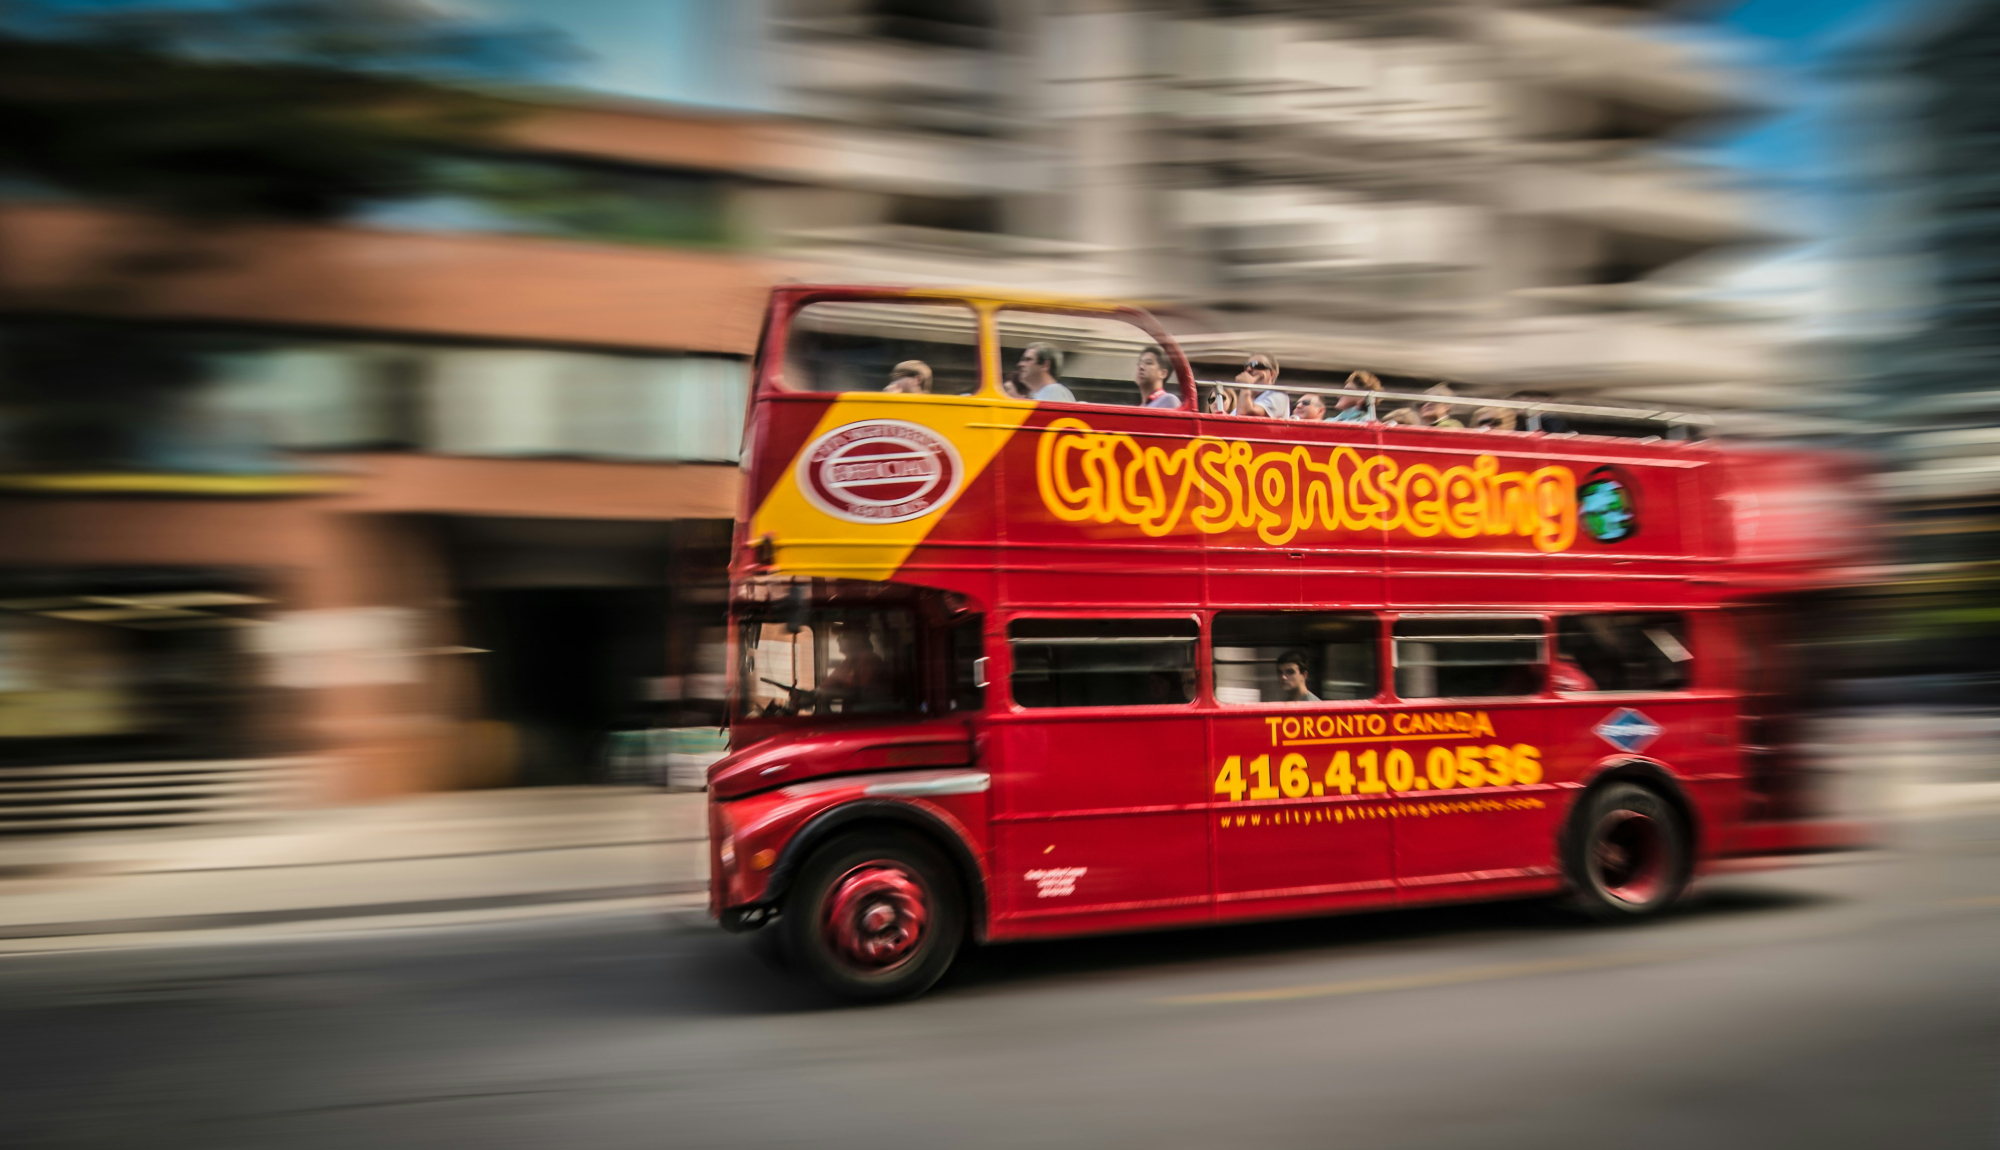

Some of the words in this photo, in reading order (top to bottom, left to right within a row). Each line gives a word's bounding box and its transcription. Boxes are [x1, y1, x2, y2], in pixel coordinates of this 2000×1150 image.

[1265, 713, 1387, 747] TORONTO
[1393, 711, 1497, 738] CANADA
[1214, 743, 1544, 802] 416.410.0536
